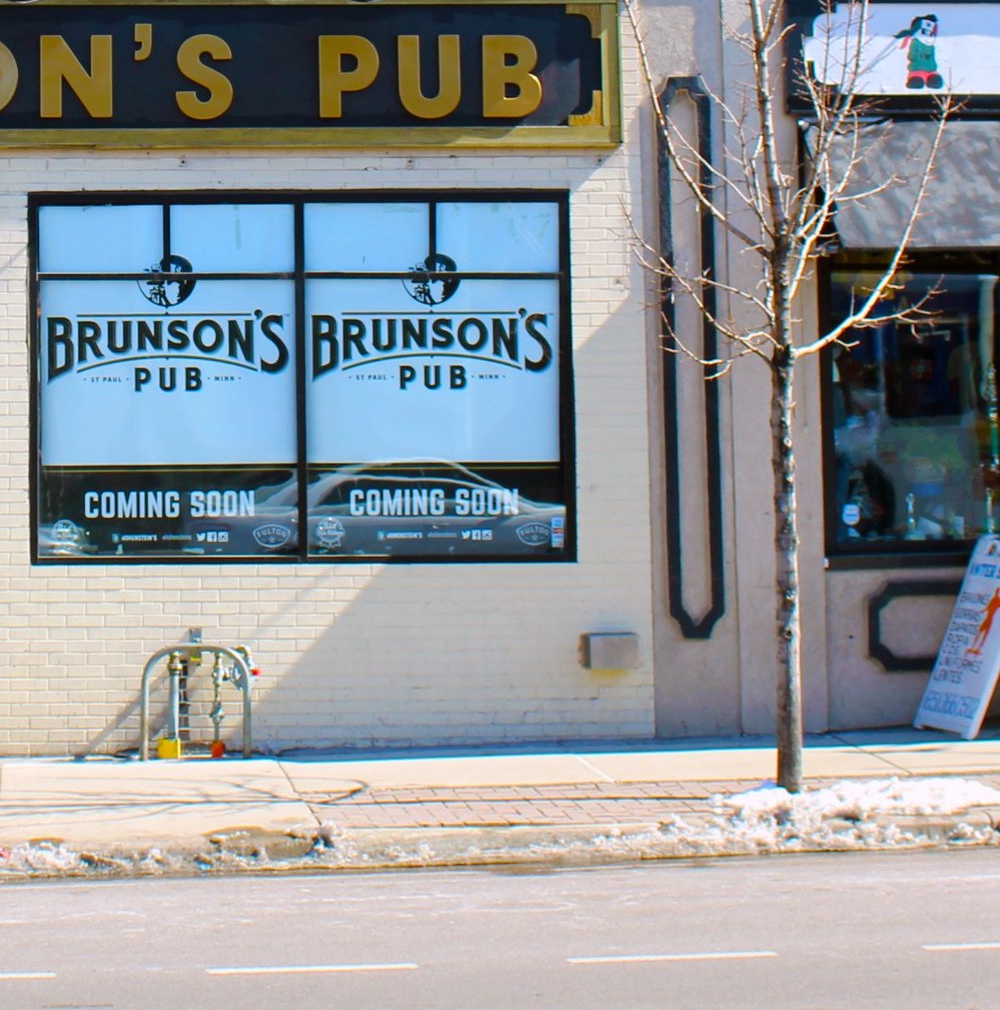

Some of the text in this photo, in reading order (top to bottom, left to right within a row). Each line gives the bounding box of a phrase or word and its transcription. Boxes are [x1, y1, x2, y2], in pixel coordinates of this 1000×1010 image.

[317, 33, 545, 120] PUB
[47, 308, 290, 385] BRUNSON'S
[311, 307, 553, 383] BRUNSON'S
[134, 367, 203, 393] PUB
[398, 365, 467, 391] PUB
[84, 490, 256, 519] COMING SOON
[349, 488, 520, 517] COMING SOON
[256, 527, 287, 539] FULTON
